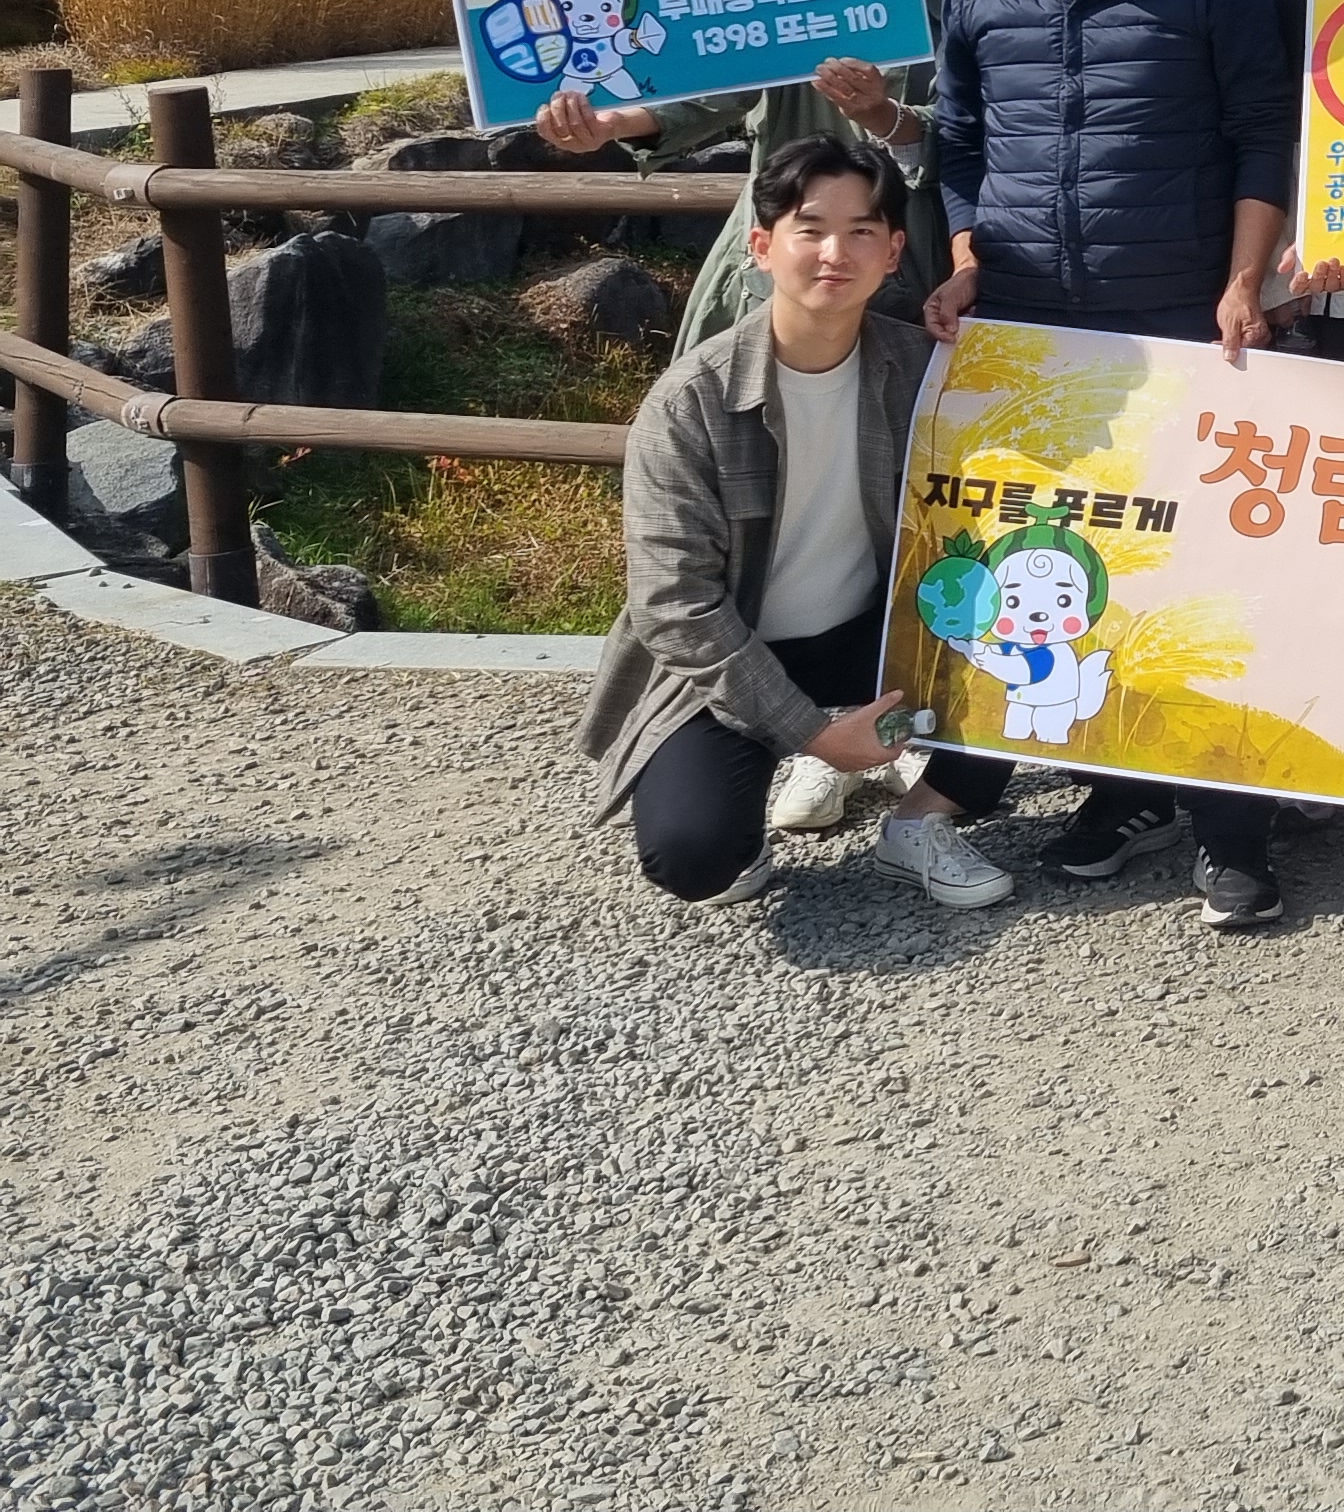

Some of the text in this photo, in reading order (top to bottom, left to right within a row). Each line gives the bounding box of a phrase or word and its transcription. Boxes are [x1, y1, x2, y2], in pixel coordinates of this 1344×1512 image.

[691, 2, 888, 57] 1398 또는 110
[923, 473, 1177, 532] 지구를 푸르게
